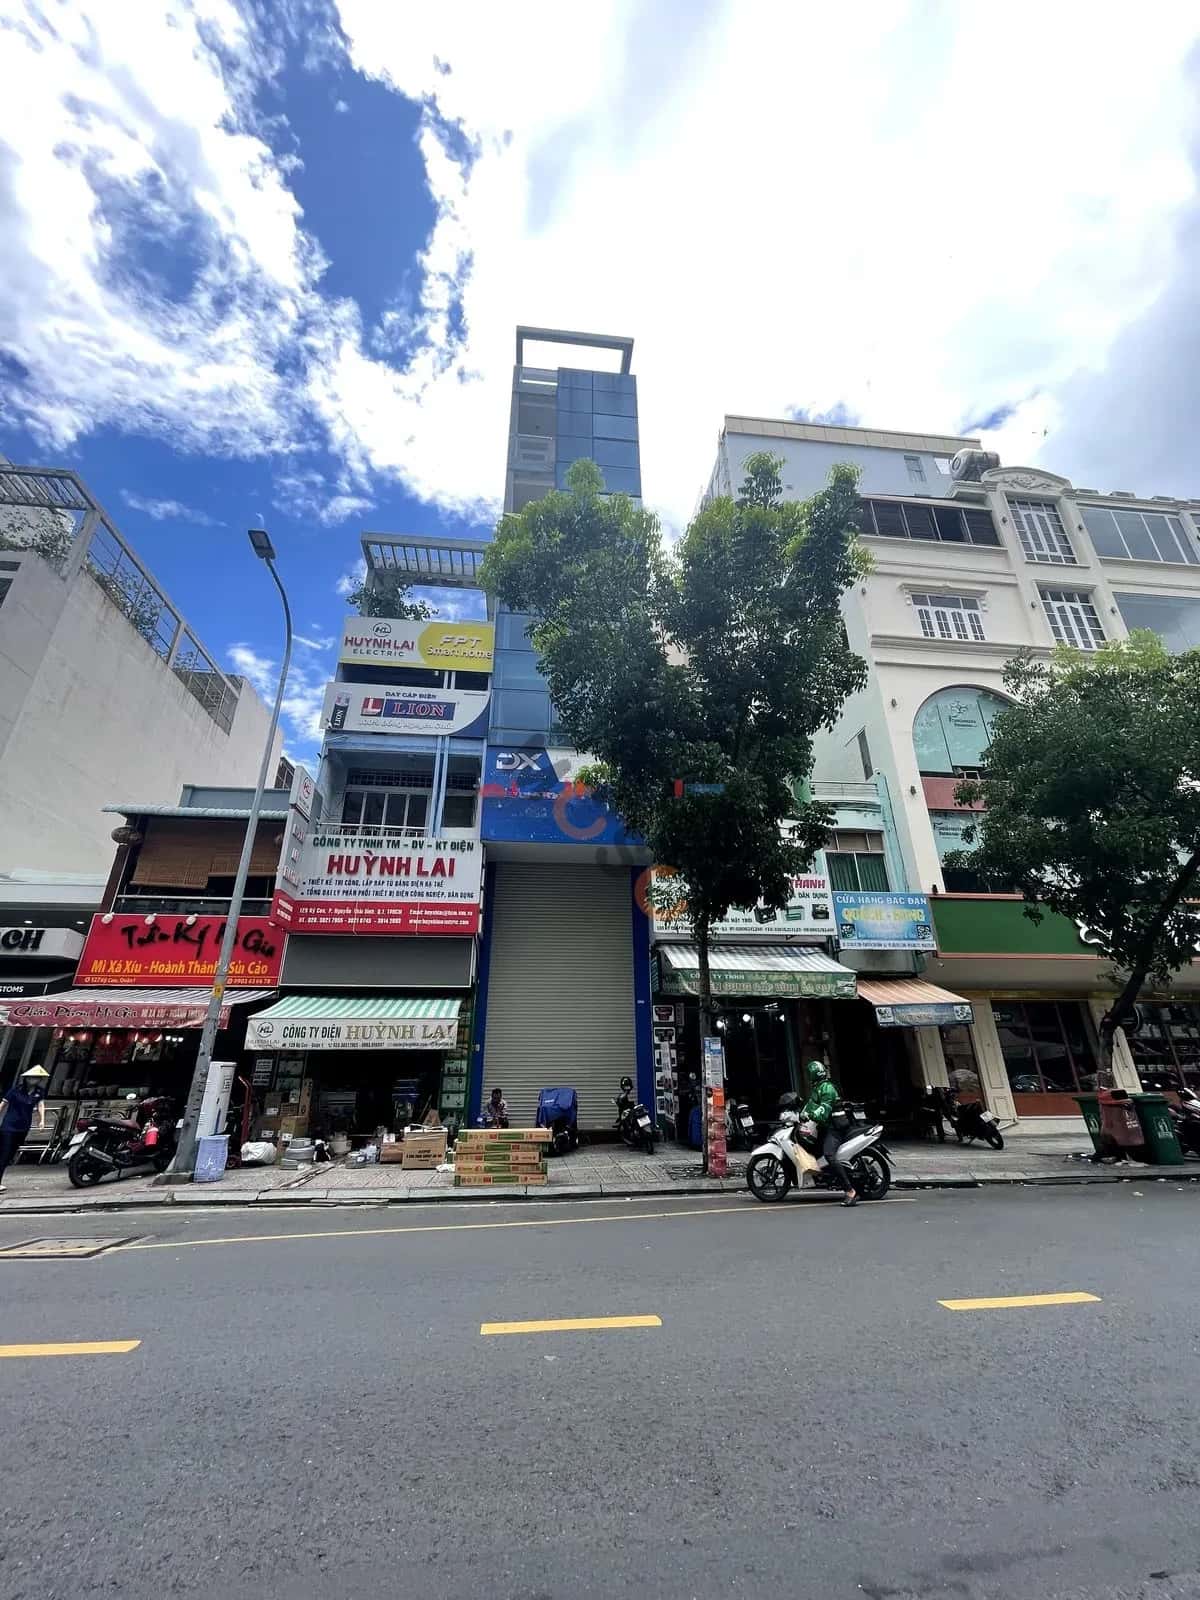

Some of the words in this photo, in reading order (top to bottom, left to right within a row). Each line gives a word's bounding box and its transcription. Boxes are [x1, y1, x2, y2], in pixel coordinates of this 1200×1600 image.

[394, 638, 414, 650] LAI
[353, 648, 405, 657] ELECTRIC
[392, 702, 448, 717] LION
[334, 710, 344, 726] LION
[496, 752, 542, 770] DX
[313, 836, 340, 847] CÔNG
[344, 838, 358, 848] TY
[358, 838, 383, 848] TNHH
[386, 839, 405, 849] TM
[412, 840, 424, 850] DV
[435, 841, 448, 850] KT
[450, 840, 474, 853] ĐIỆN
[327, 850, 412, 877] HUỲNH
[416, 858, 456, 878] LAI
[91, 959, 105, 973] Mì
[124, 960, 142, 973] Xíu
[149, 960, 185, 974] Hoành
[282, 1024, 306, 1038] CÔNG
[310, 1027, 319, 1038] TY
[322, 1024, 341, 1041] ĐIỆN
[346, 1021, 415, 1039] HUỲNH
